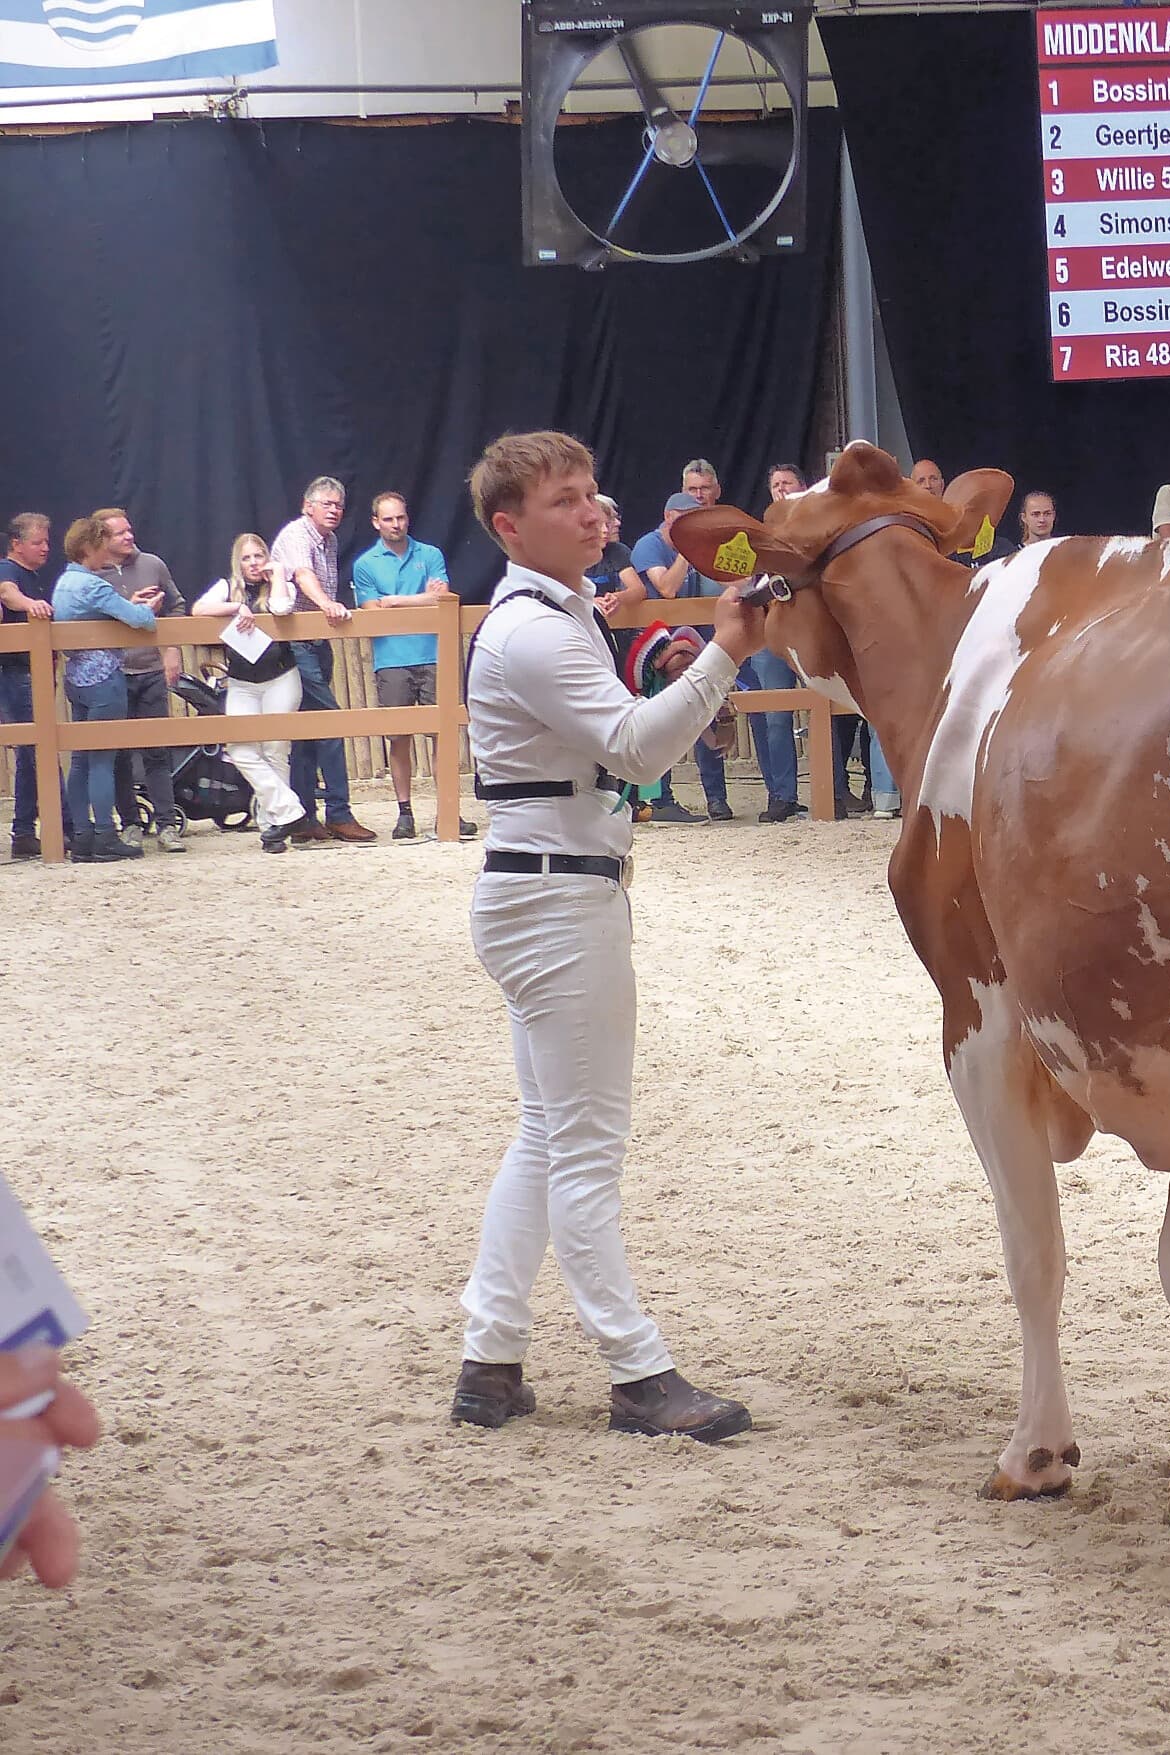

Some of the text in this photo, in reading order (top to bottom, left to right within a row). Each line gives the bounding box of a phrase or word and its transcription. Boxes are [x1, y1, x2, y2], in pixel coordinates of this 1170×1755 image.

[1048, 80, 1059, 106] 1
[1049, 124, 1062, 150] 2
[1095, 123, 1170, 151] Geertje
[1051, 168, 1064, 195] 3
[1096, 166, 1155, 192] Willie
[1053, 214, 1067, 238] 4
[1055, 257, 1069, 284] 5
[1058, 301, 1071, 328] 6
[1059, 346, 1072, 372] 7
[1105, 343, 1141, 368] Ria
[716, 556, 748, 574] 2338
